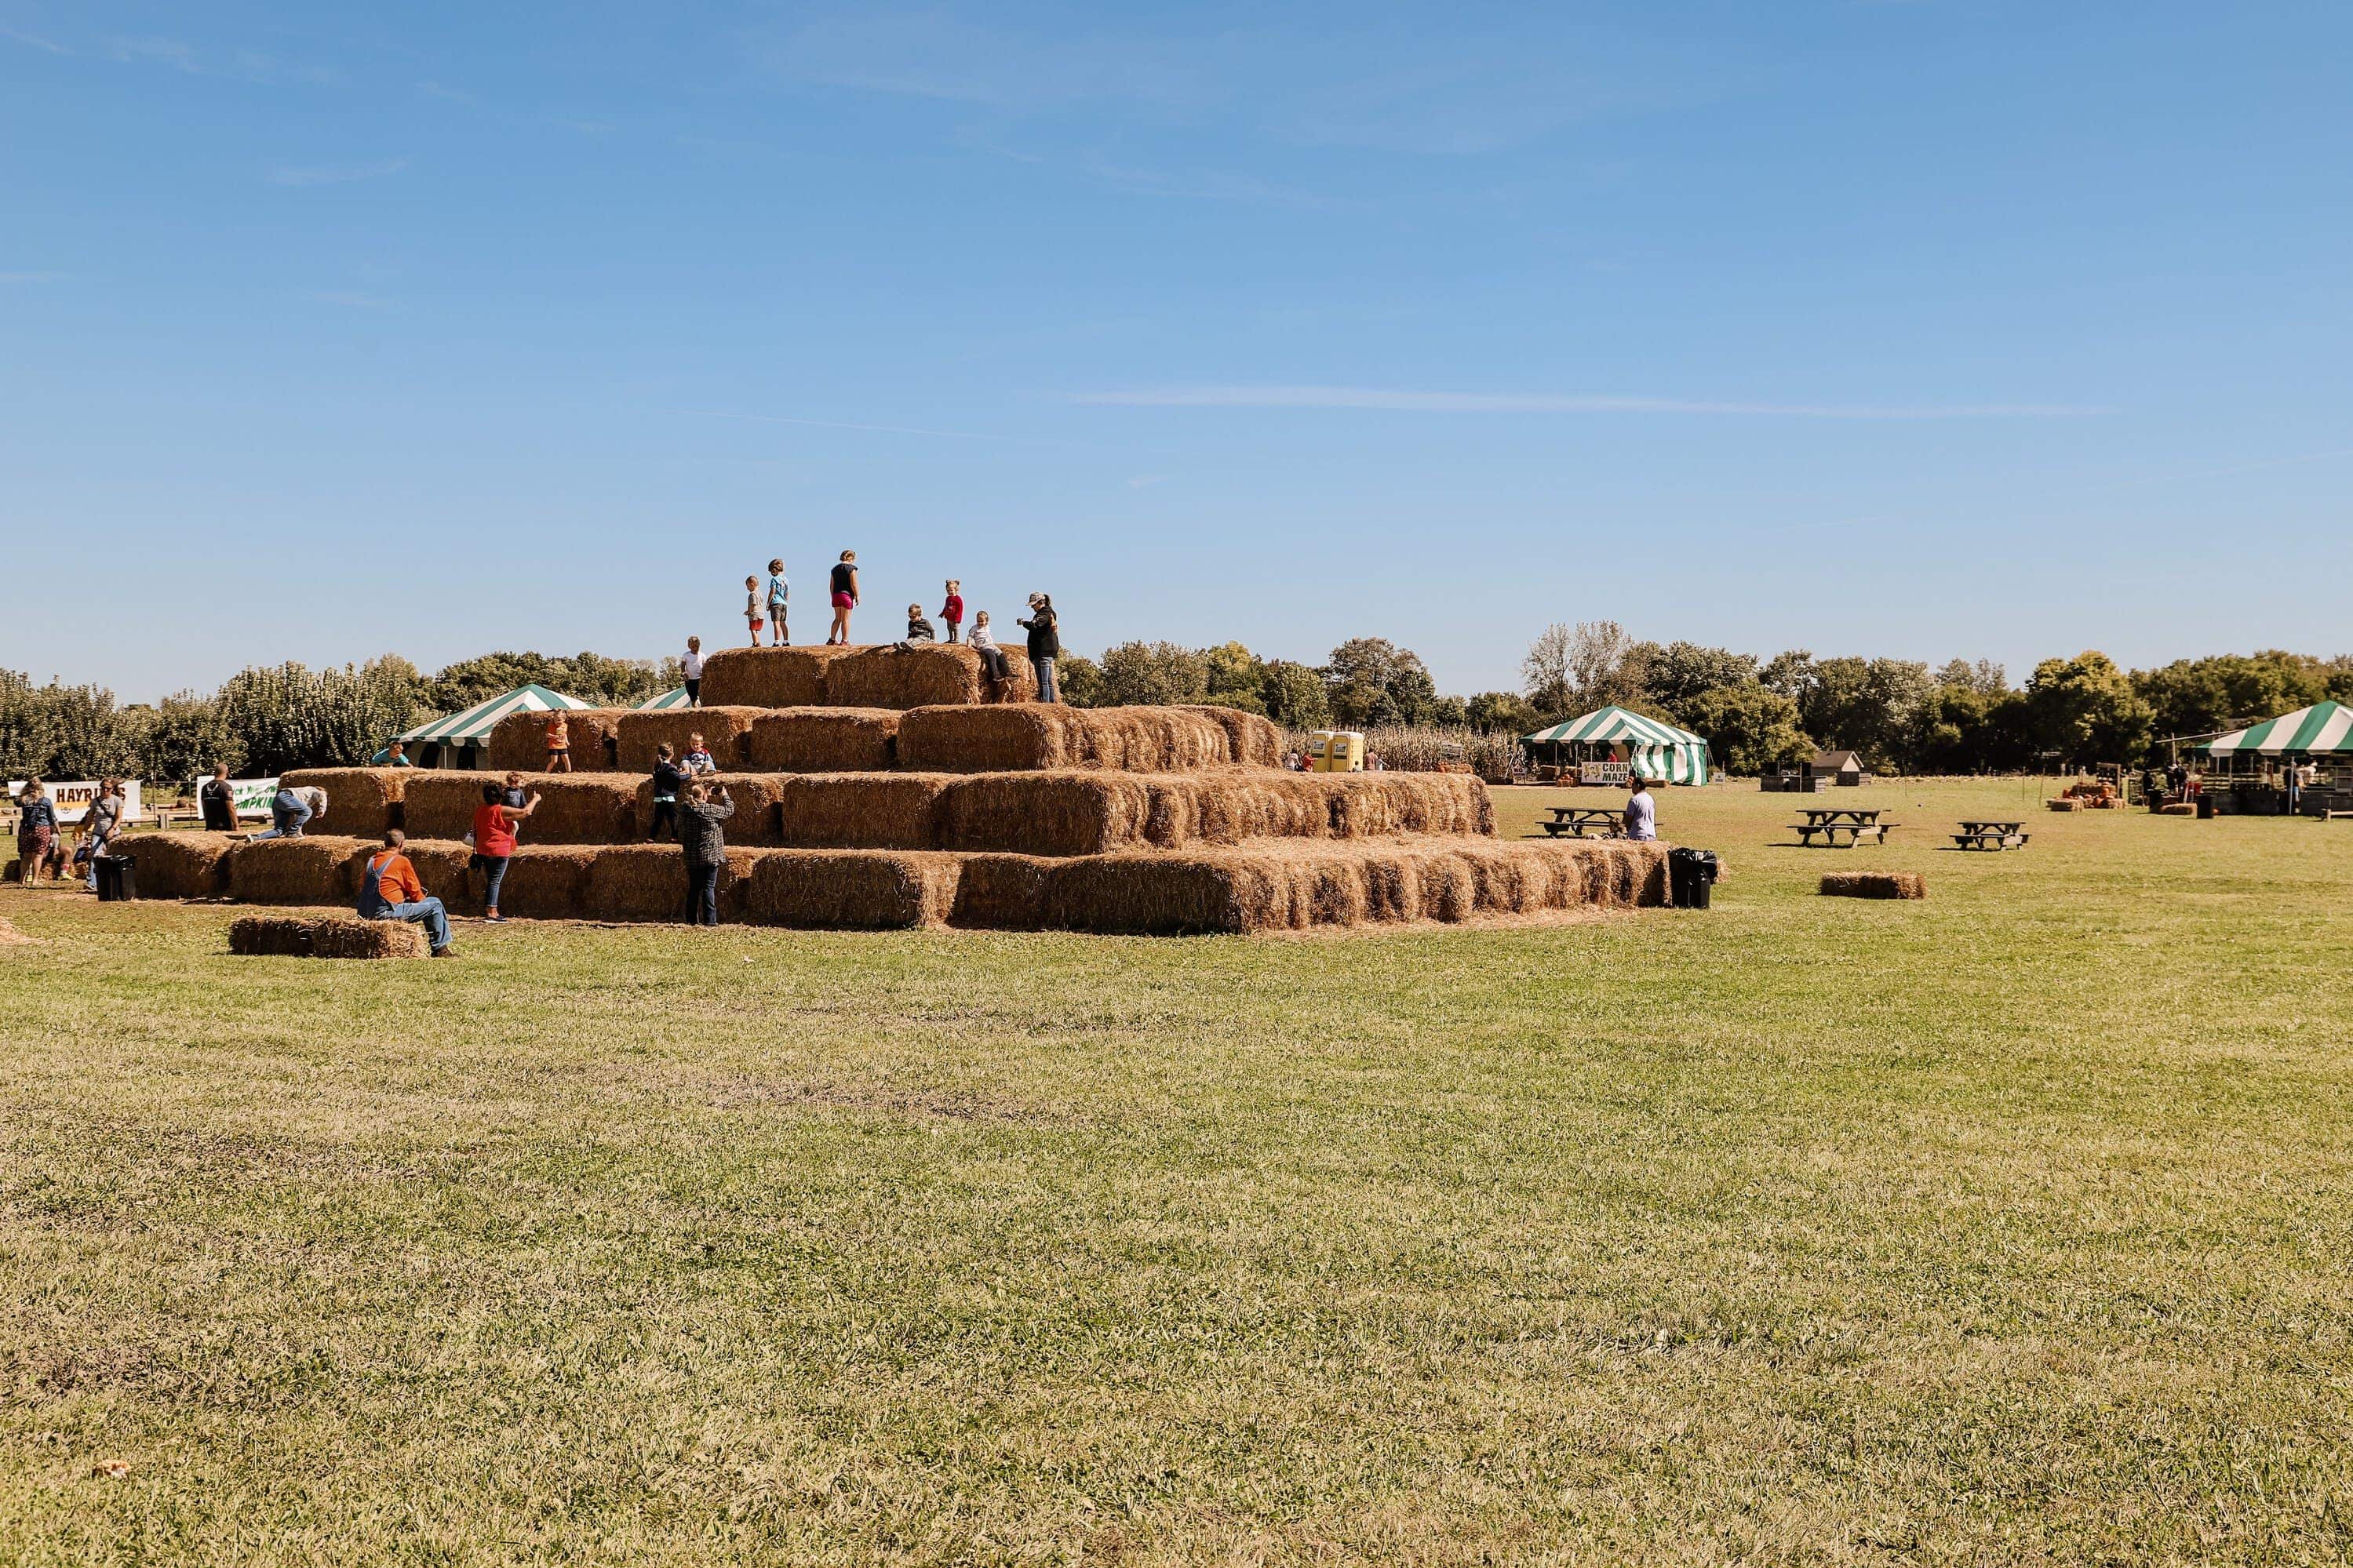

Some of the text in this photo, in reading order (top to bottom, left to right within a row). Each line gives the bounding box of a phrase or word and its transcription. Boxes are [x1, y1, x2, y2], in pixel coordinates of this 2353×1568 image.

[1602, 763, 1628, 773] CORN
[1602, 773, 1628, 781] MAZE
[56, 788, 126, 802] HAYRIS
[235, 796, 275, 809] MPKIN
